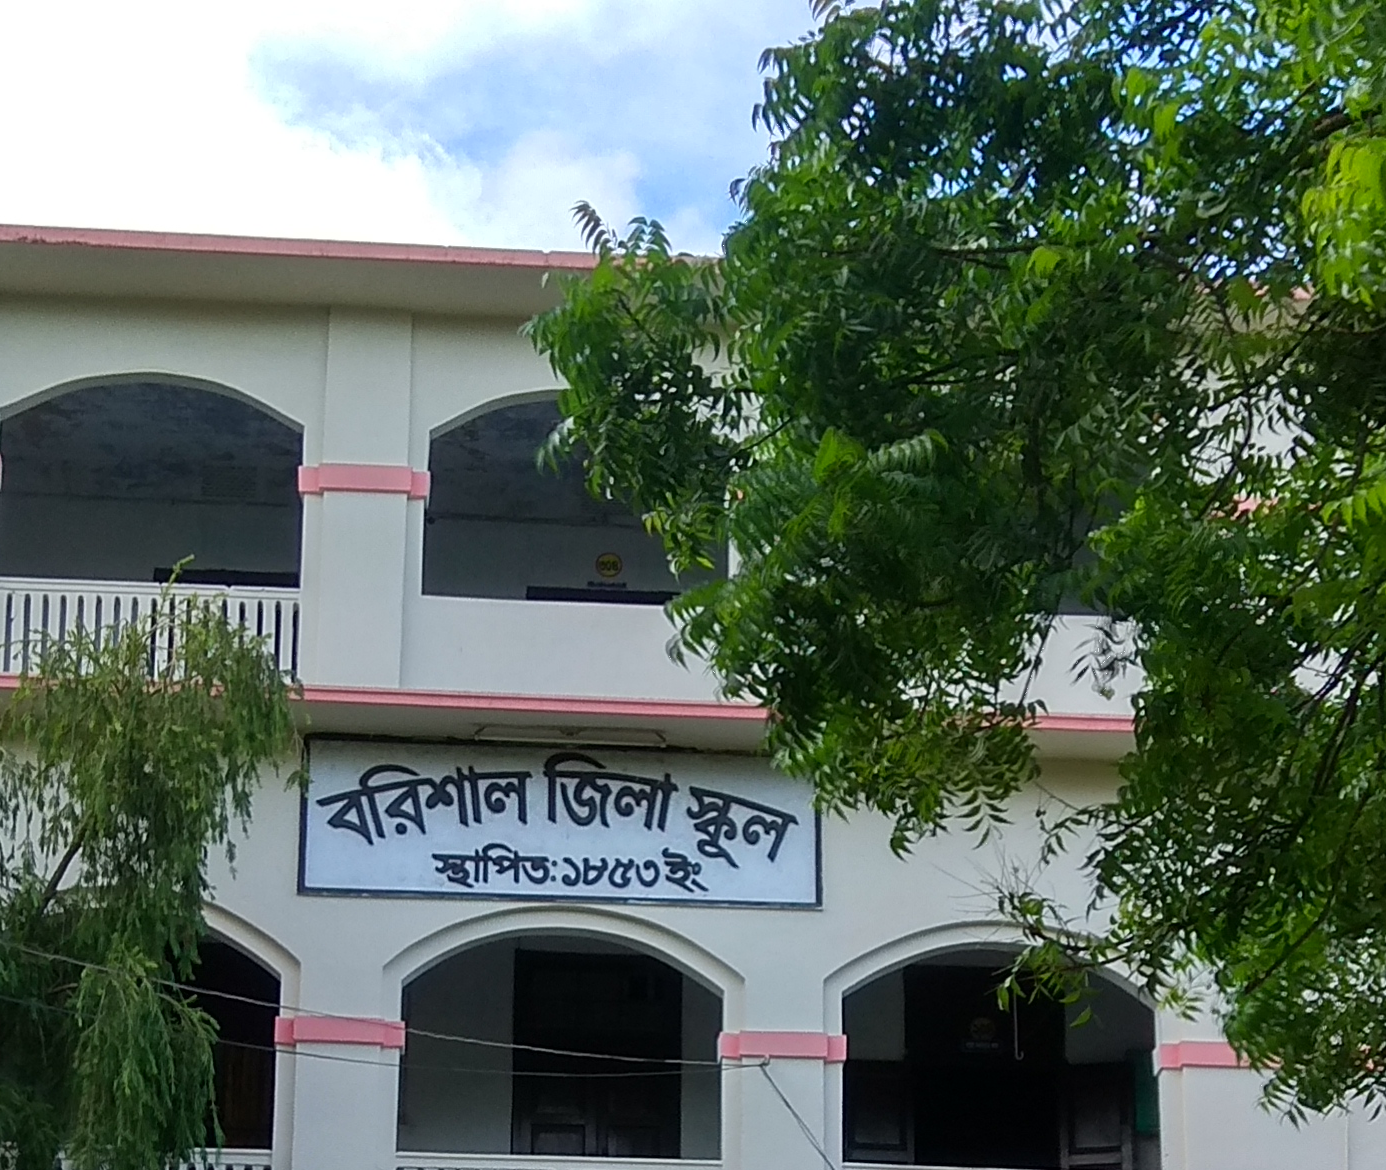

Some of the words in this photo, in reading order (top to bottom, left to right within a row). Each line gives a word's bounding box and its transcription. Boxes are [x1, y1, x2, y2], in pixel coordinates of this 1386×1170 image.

[317, 764, 532, 844] বরিশাল
[544, 752, 678, 831] জিলা
[687, 785, 799, 868] স্কুল
